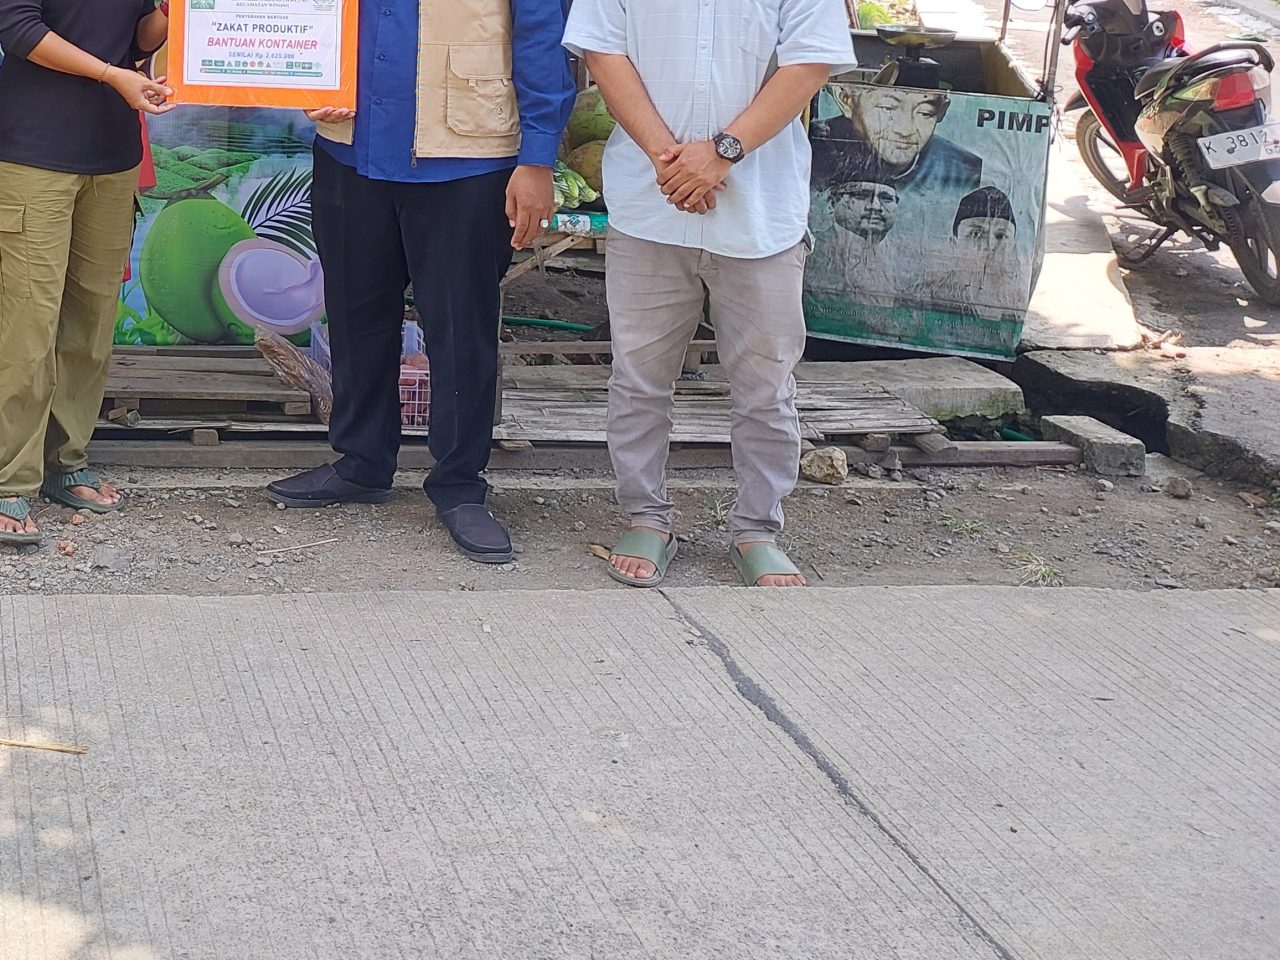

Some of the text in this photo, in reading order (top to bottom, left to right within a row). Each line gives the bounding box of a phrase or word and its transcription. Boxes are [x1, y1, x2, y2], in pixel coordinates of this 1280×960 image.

[207, 37, 318, 50] BANTUAN KONTAINER
[977, 108, 1050, 134] PIMP
[1203, 141, 1217, 154] K
